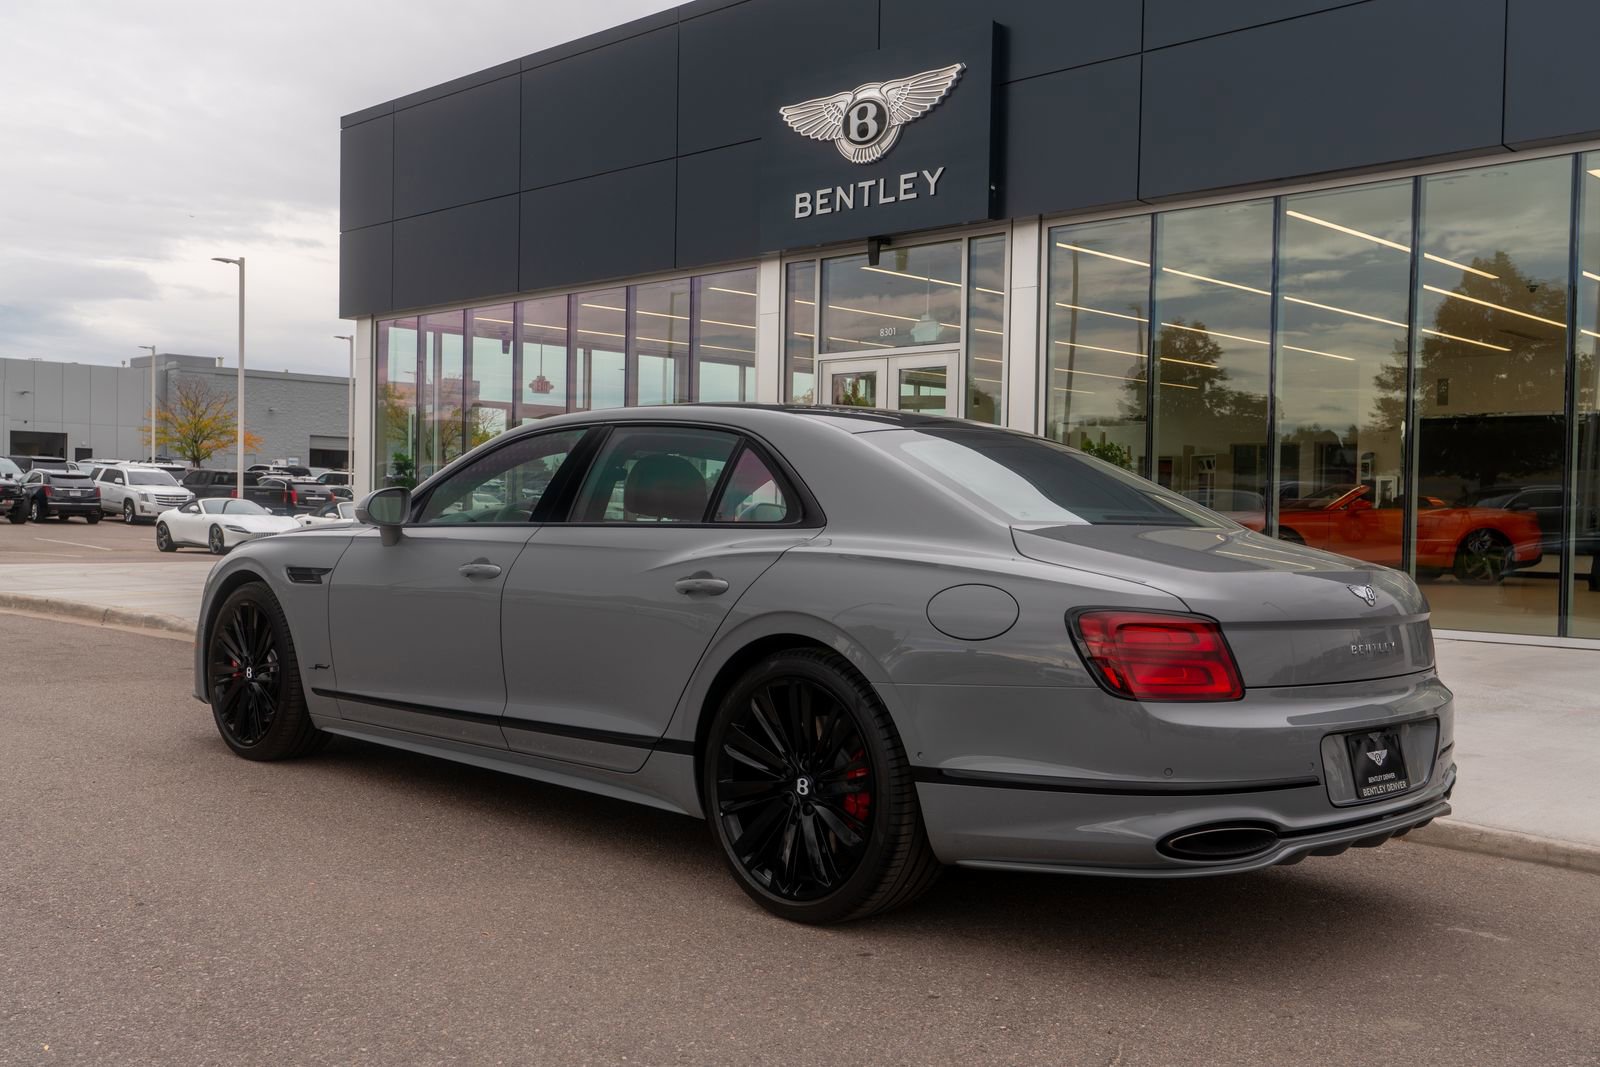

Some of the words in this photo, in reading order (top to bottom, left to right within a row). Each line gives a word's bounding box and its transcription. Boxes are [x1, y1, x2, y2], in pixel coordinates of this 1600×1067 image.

[849, 102, 878, 141] B
[795, 167, 945, 219] BENTLEY
[880, 327, 896, 337] 8301
[797, 778, 809, 795] B
[1363, 784, 1386, 796] BENTLEY
[1386, 781, 1407, 792] DENVER
